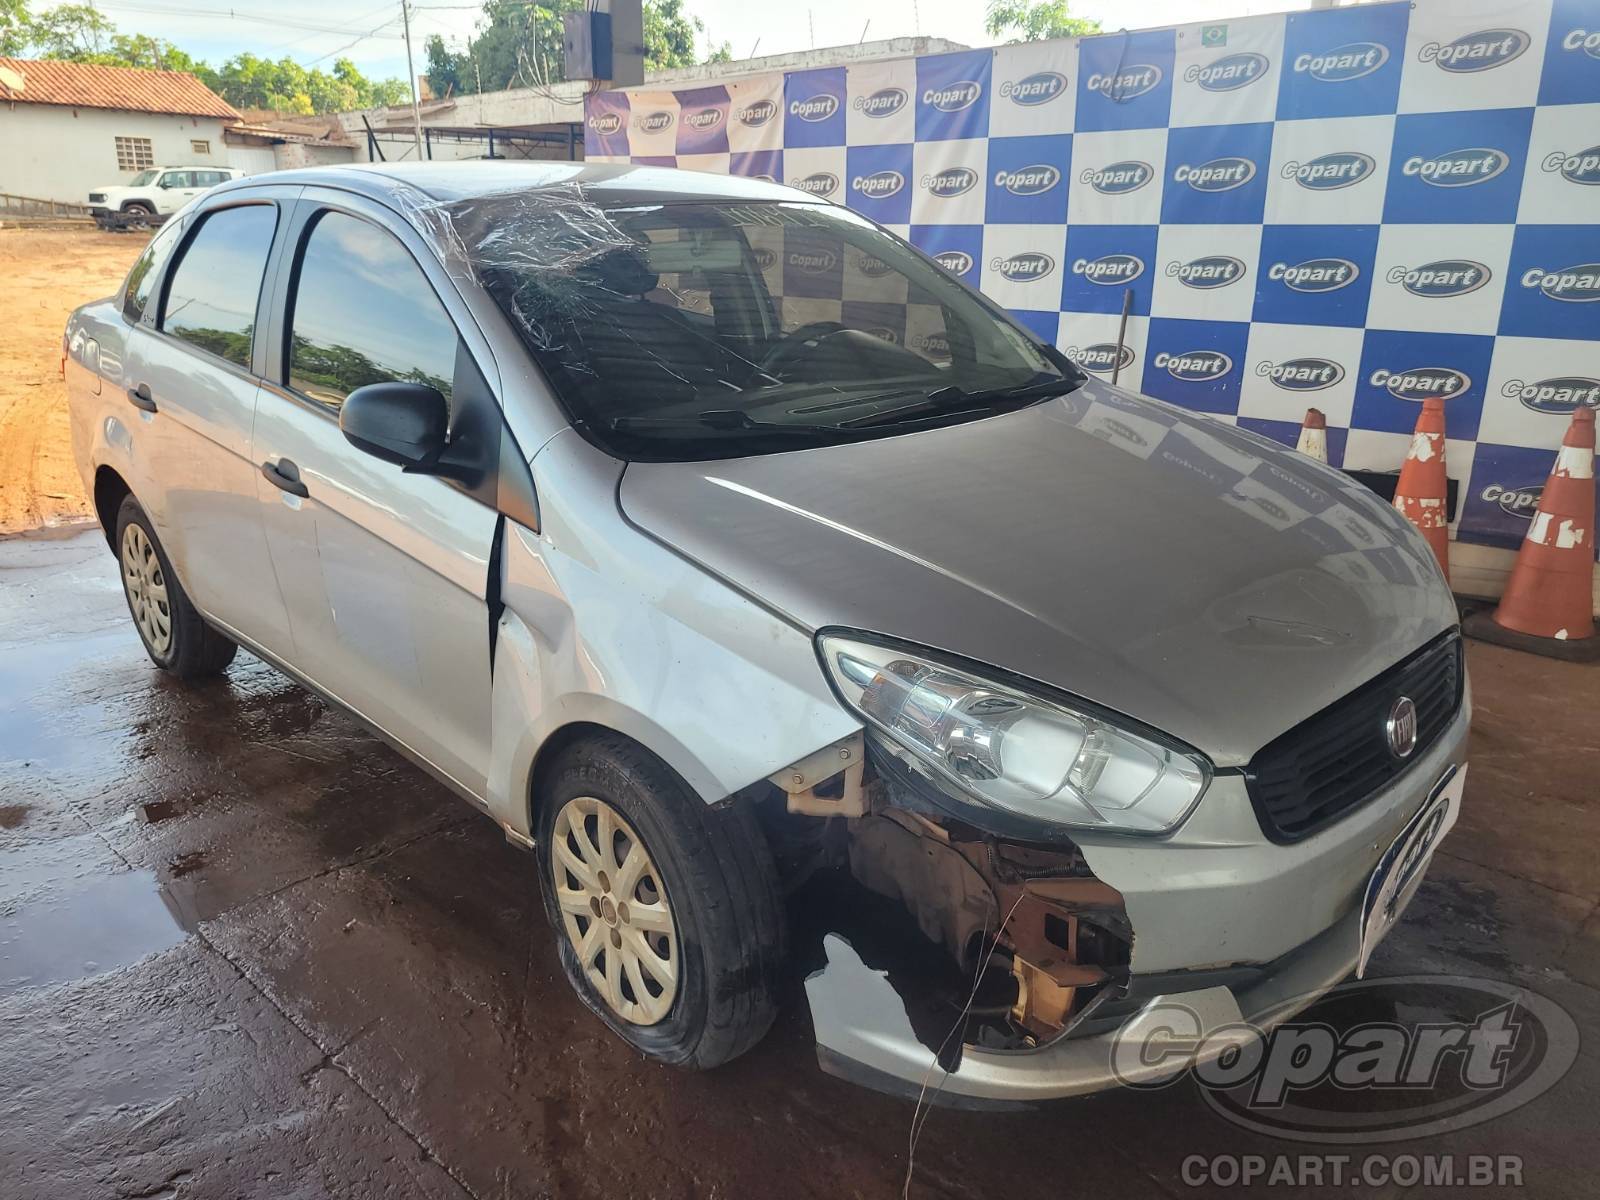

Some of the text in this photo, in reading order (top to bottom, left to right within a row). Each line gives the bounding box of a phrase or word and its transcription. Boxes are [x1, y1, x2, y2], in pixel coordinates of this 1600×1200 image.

[1418, 37, 1513, 64] Copart
[1184, 58, 1257, 83] Copart
[1294, 50, 1377, 74] Copart
[922, 85, 976, 110] Copart
[999, 76, 1057, 98] Copart
[790, 96, 835, 117] Copart
[854, 91, 902, 114] Copart
[588, 113, 618, 130] Copart
[684, 109, 719, 128] Copart
[1280, 160, 1361, 184] Copart
[1402, 152, 1495, 180] Copart
[1541, 151, 1600, 175] Cop
[852, 173, 900, 195] Copart
[920, 171, 974, 197] Copart
[994, 168, 1053, 189] Copart
[1080, 167, 1145, 189] Copart
[1174, 163, 1247, 186] Copart
[990, 256, 1047, 275] Copart
[1072, 258, 1135, 279] Copart
[1165, 260, 1236, 282] Copart
[1268, 263, 1348, 285] Copart
[1386, 266, 1477, 289] Copart
[1153, 352, 1223, 374] Copart
[1255, 360, 1332, 382] Copart
[1369, 369, 1457, 393] Copart
[1501, 378, 1600, 404] Copart
